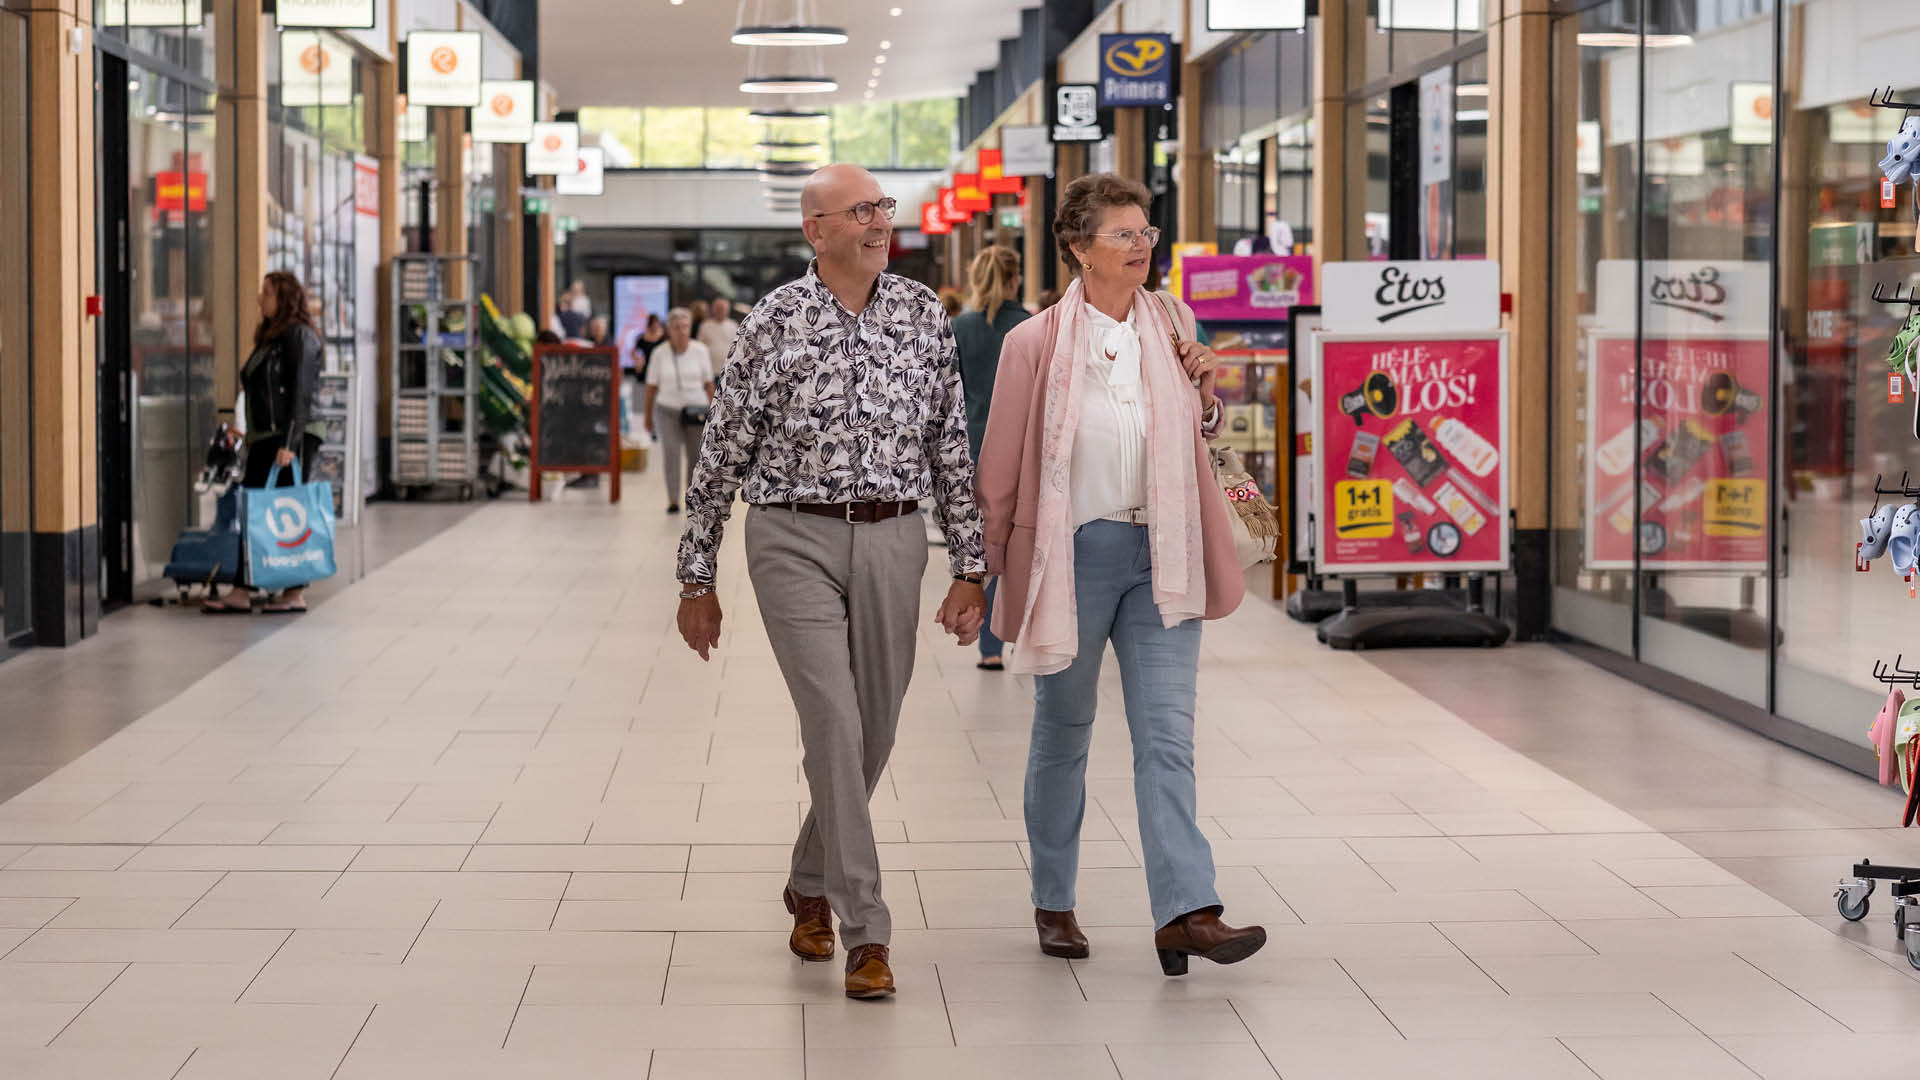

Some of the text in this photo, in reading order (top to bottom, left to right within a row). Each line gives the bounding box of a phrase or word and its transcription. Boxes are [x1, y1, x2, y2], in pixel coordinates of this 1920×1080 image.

[1104, 77, 1168, 100] Primera
[1375, 266, 1446, 306] Etos
[1390, 359, 1454, 386] MAAL
[1400, 373, 1477, 416] LOS!
[1347, 485, 1382, 506] 1+1
[1347, 506, 1383, 521] gratis
